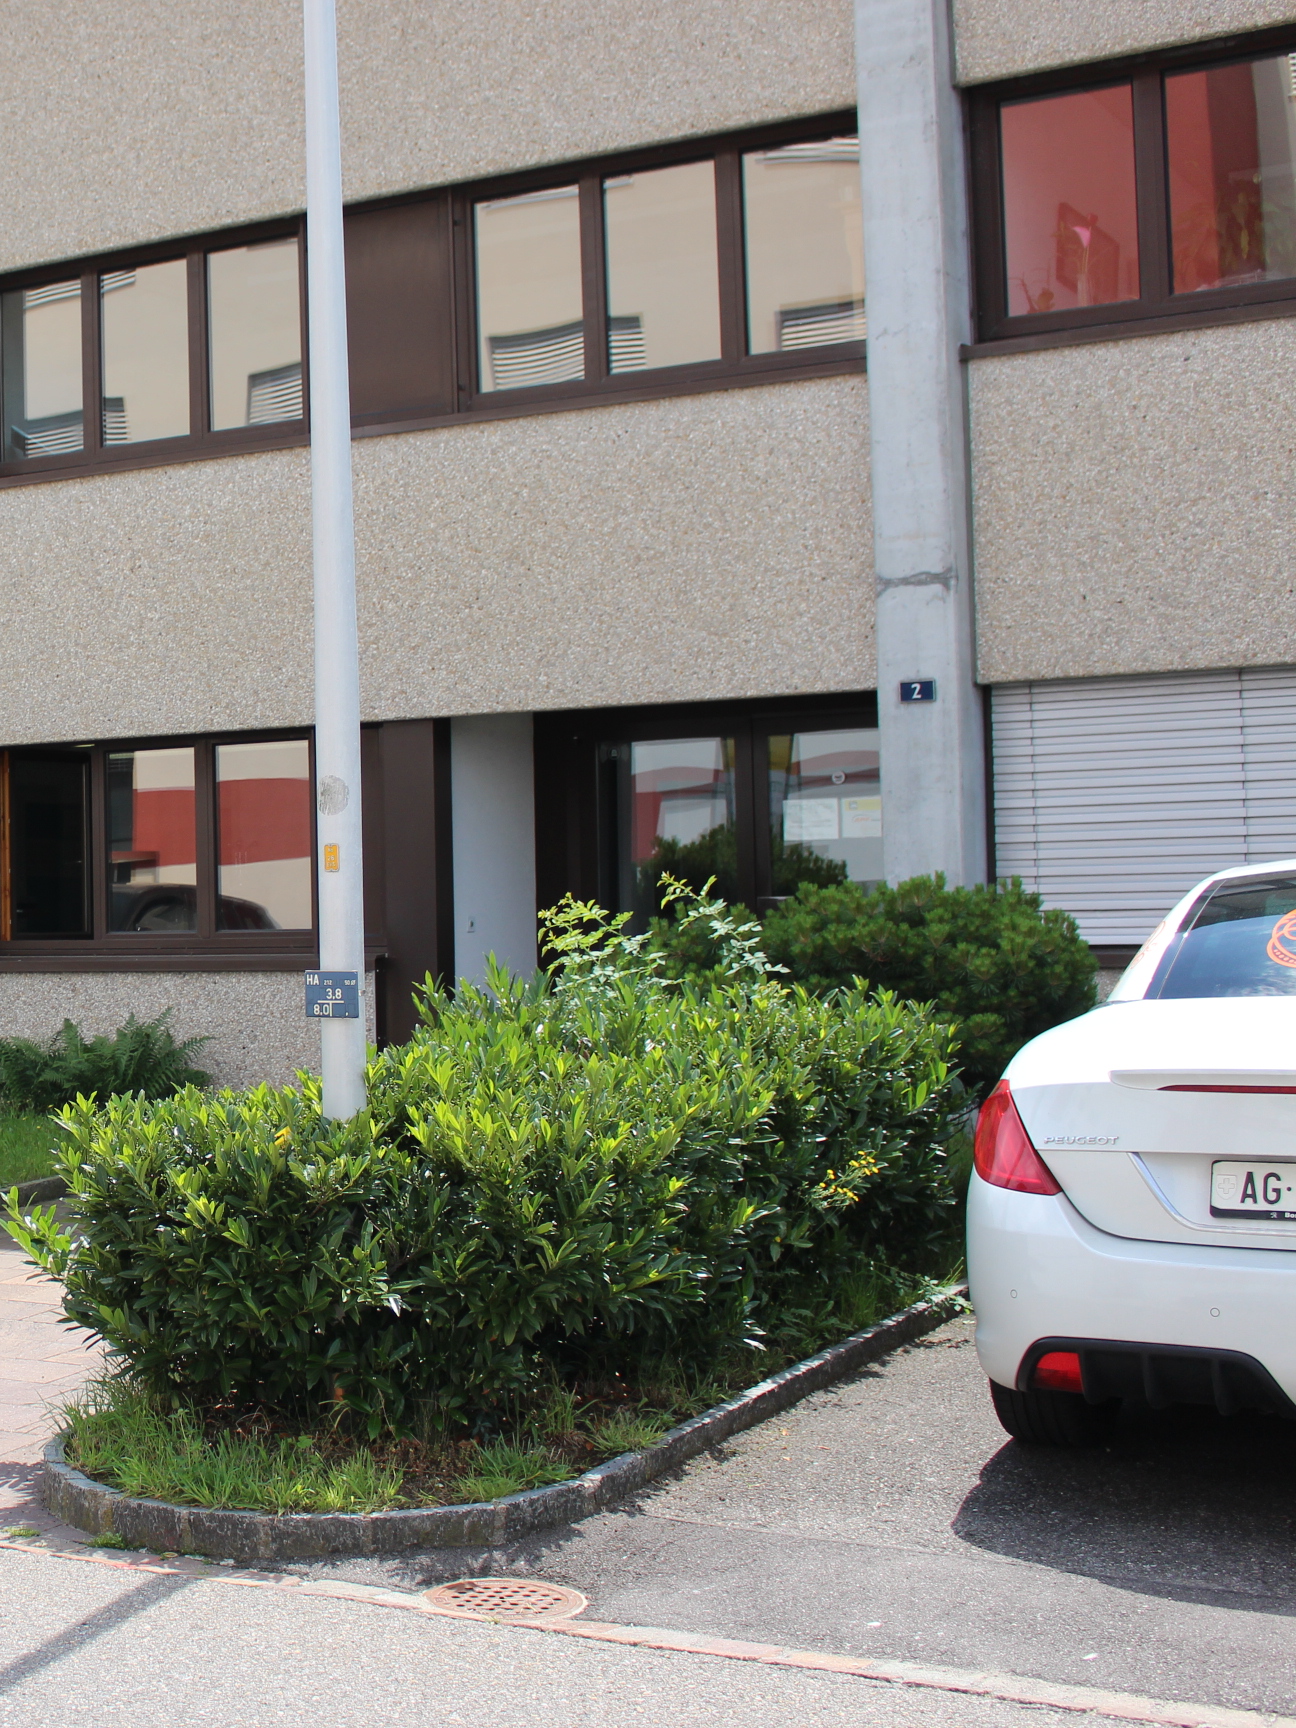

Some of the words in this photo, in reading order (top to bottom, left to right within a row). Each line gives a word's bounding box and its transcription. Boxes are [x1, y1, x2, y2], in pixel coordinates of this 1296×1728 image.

[910, 682, 922, 699] 2
[306, 974, 320, 985] HA
[1043, 1135, 1119, 1145] PEUGEOT
